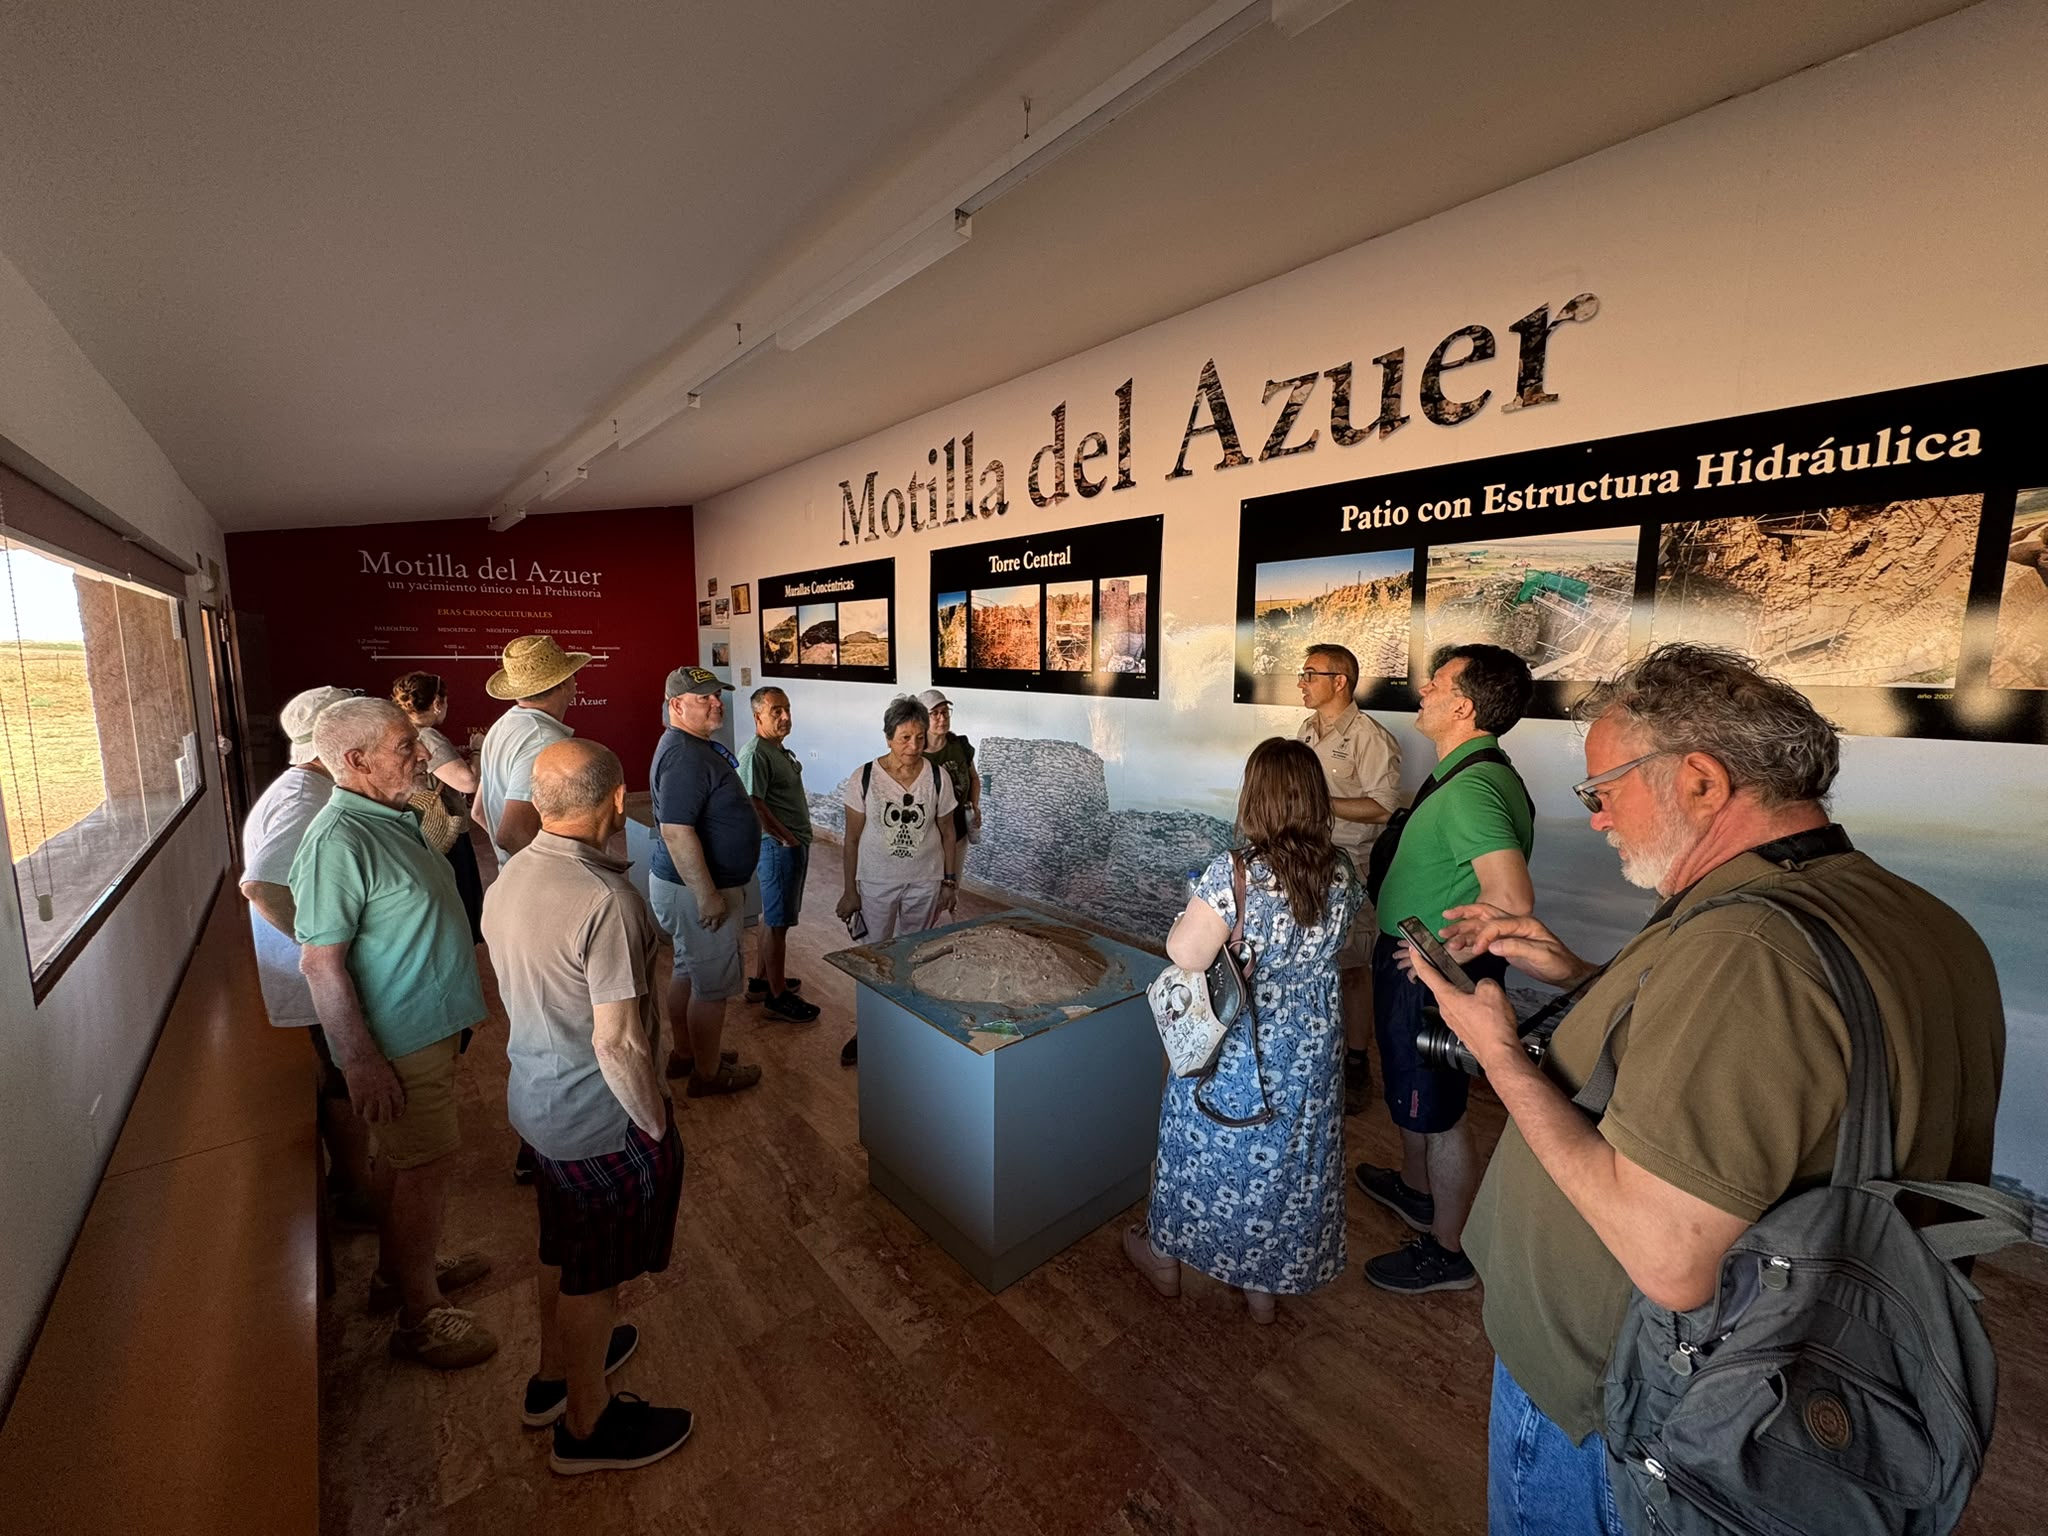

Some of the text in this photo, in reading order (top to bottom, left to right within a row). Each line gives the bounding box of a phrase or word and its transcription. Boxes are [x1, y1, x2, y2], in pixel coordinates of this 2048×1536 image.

[839, 292, 1600, 547] Motilla del Azuer
[1340, 424, 1982, 532] Patio con Estructura Hidráulica
[358, 549, 602, 586] Motilla del Azuer
[988, 545, 1071, 573] Torre Central
[387, 580, 601, 598] un yacimiento único en la Prehistoria
[784, 577, 855, 598] Murallas Concéntricas
[437, 608, 553, 618] ERAS CRONOCULTURALES
[580, 697, 608, 706] Azuer
